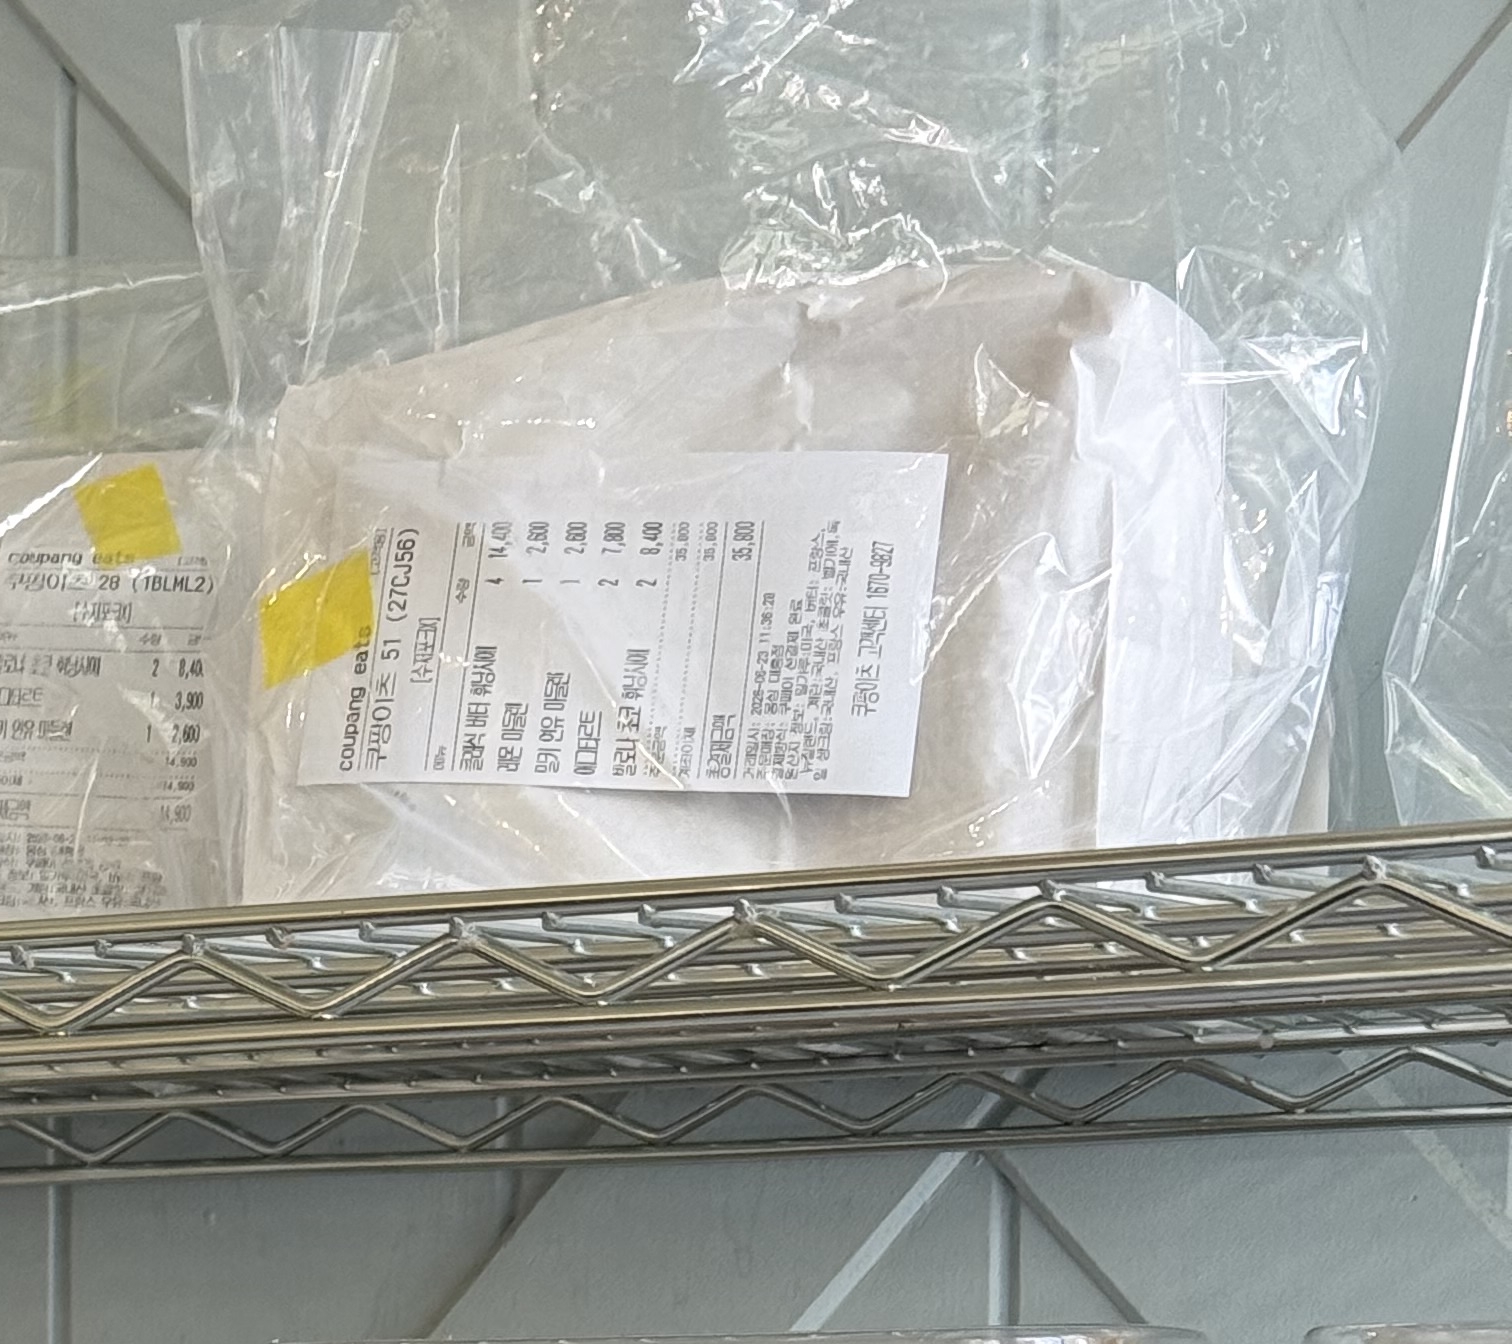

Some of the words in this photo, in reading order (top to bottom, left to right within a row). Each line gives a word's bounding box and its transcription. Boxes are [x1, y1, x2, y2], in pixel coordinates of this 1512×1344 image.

[487, 521, 512, 558] 14,400
[564, 521, 587, 554] 2,600
[601, 521, 626, 554] 7,800
[640, 521, 663, 555] 8,400
[732, 521, 754, 561] 35,800
[7, 551, 83, 566] coupang
[98, 574, 120, 591] 28
[385, 528, 419, 622] (27CJ56)
[485, 577, 504, 585] 4
[598, 579, 619, 587] 2
[636, 578, 657, 587] 2
[351, 626, 372, 674] eats
[381, 639, 401, 660] 51
[497, 746, 523, 772] 레몬
[526, 521, 549, 554] 2,600
[151, 658, 160, 678] 2
[466, 702, 491, 727] 버터
[339, 687, 366, 771] coupang
[538, 716, 563, 742] 연유
[534, 748, 561, 773] 밀키
